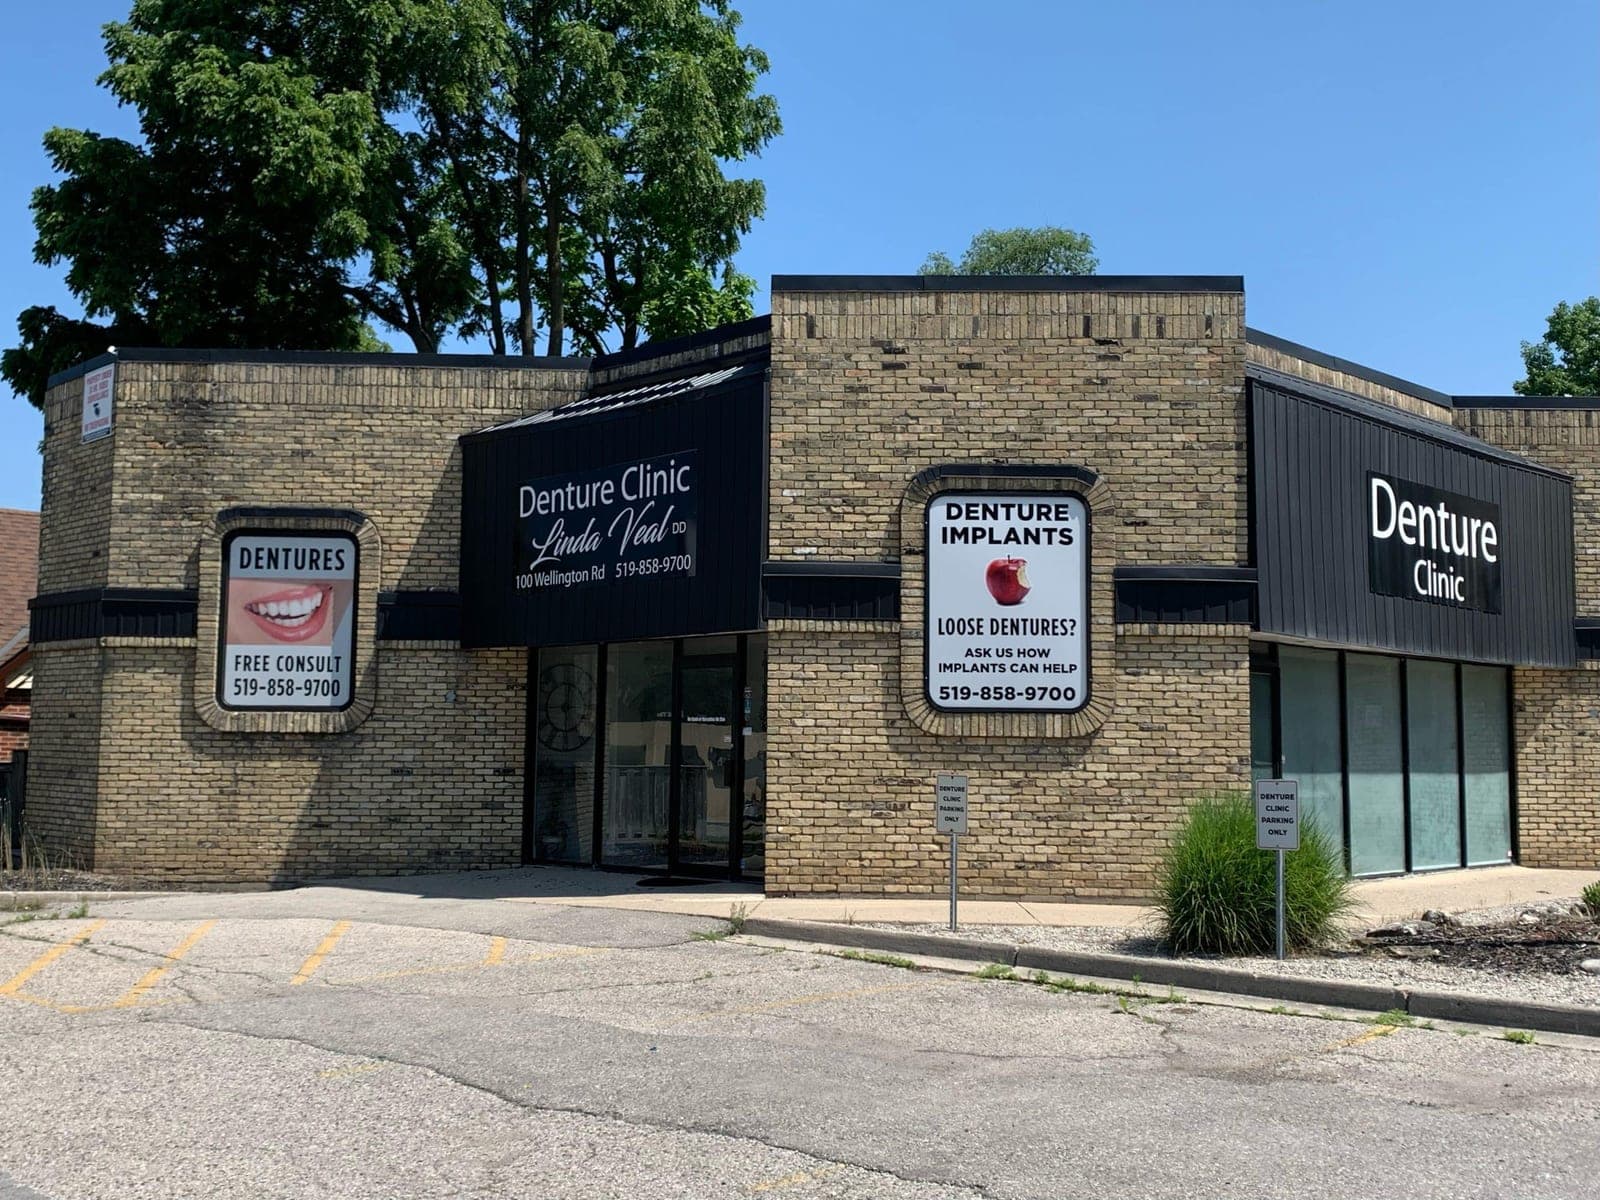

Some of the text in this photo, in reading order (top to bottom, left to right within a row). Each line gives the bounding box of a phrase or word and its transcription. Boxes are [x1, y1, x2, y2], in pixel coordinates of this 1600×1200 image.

[520, 459, 690, 518] Denture Clinic
[946, 503, 1069, 521] DENTURE
[1371, 477, 1497, 563] Denture
[529, 500, 687, 571] Linda Veal DD
[941, 527, 1074, 545] IMPLANTS
[239, 547, 345, 571] DENTURES
[515, 554, 692, 589] 100 Wellington Rd 519-858-9700
[1414, 559, 1465, 602] Clinic
[938, 617, 1077, 636] LOOSE DENTURES?
[965, 648, 1051, 658] ASK US HOW
[234, 655, 342, 673] FREE CONSULT
[938, 663, 1077, 674] IMPLANTS CAN HELP
[233, 678, 340, 697] 519-858-9700
[939, 686, 1076, 701] 519-858-9700
[1260, 793, 1295, 801] DENTURE
